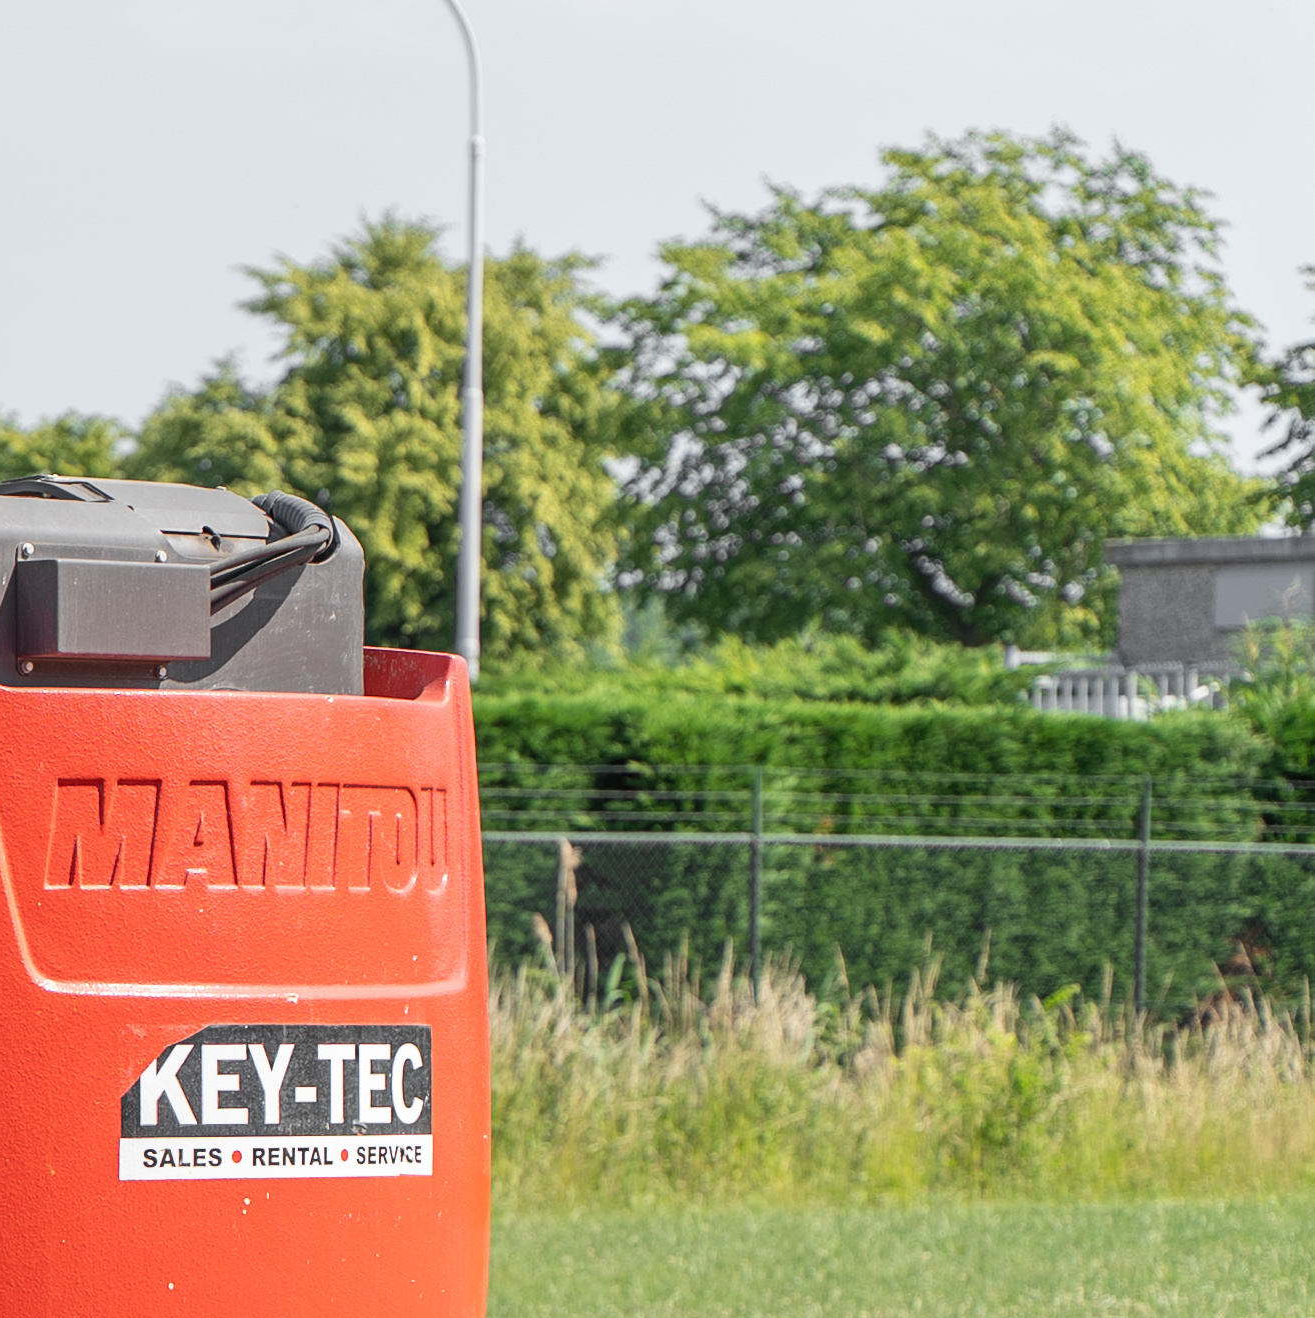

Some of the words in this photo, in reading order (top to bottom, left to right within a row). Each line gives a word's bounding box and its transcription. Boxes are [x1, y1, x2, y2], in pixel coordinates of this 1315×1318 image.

[43, 777, 449, 896] MANITOU
[139, 1042, 424, 1127] KEY-TEC
[142, 1147, 223, 1168] SALES
[252, 1146, 334, 1167] RENTAL
[356, 1145, 422, 1165] SERVICE
